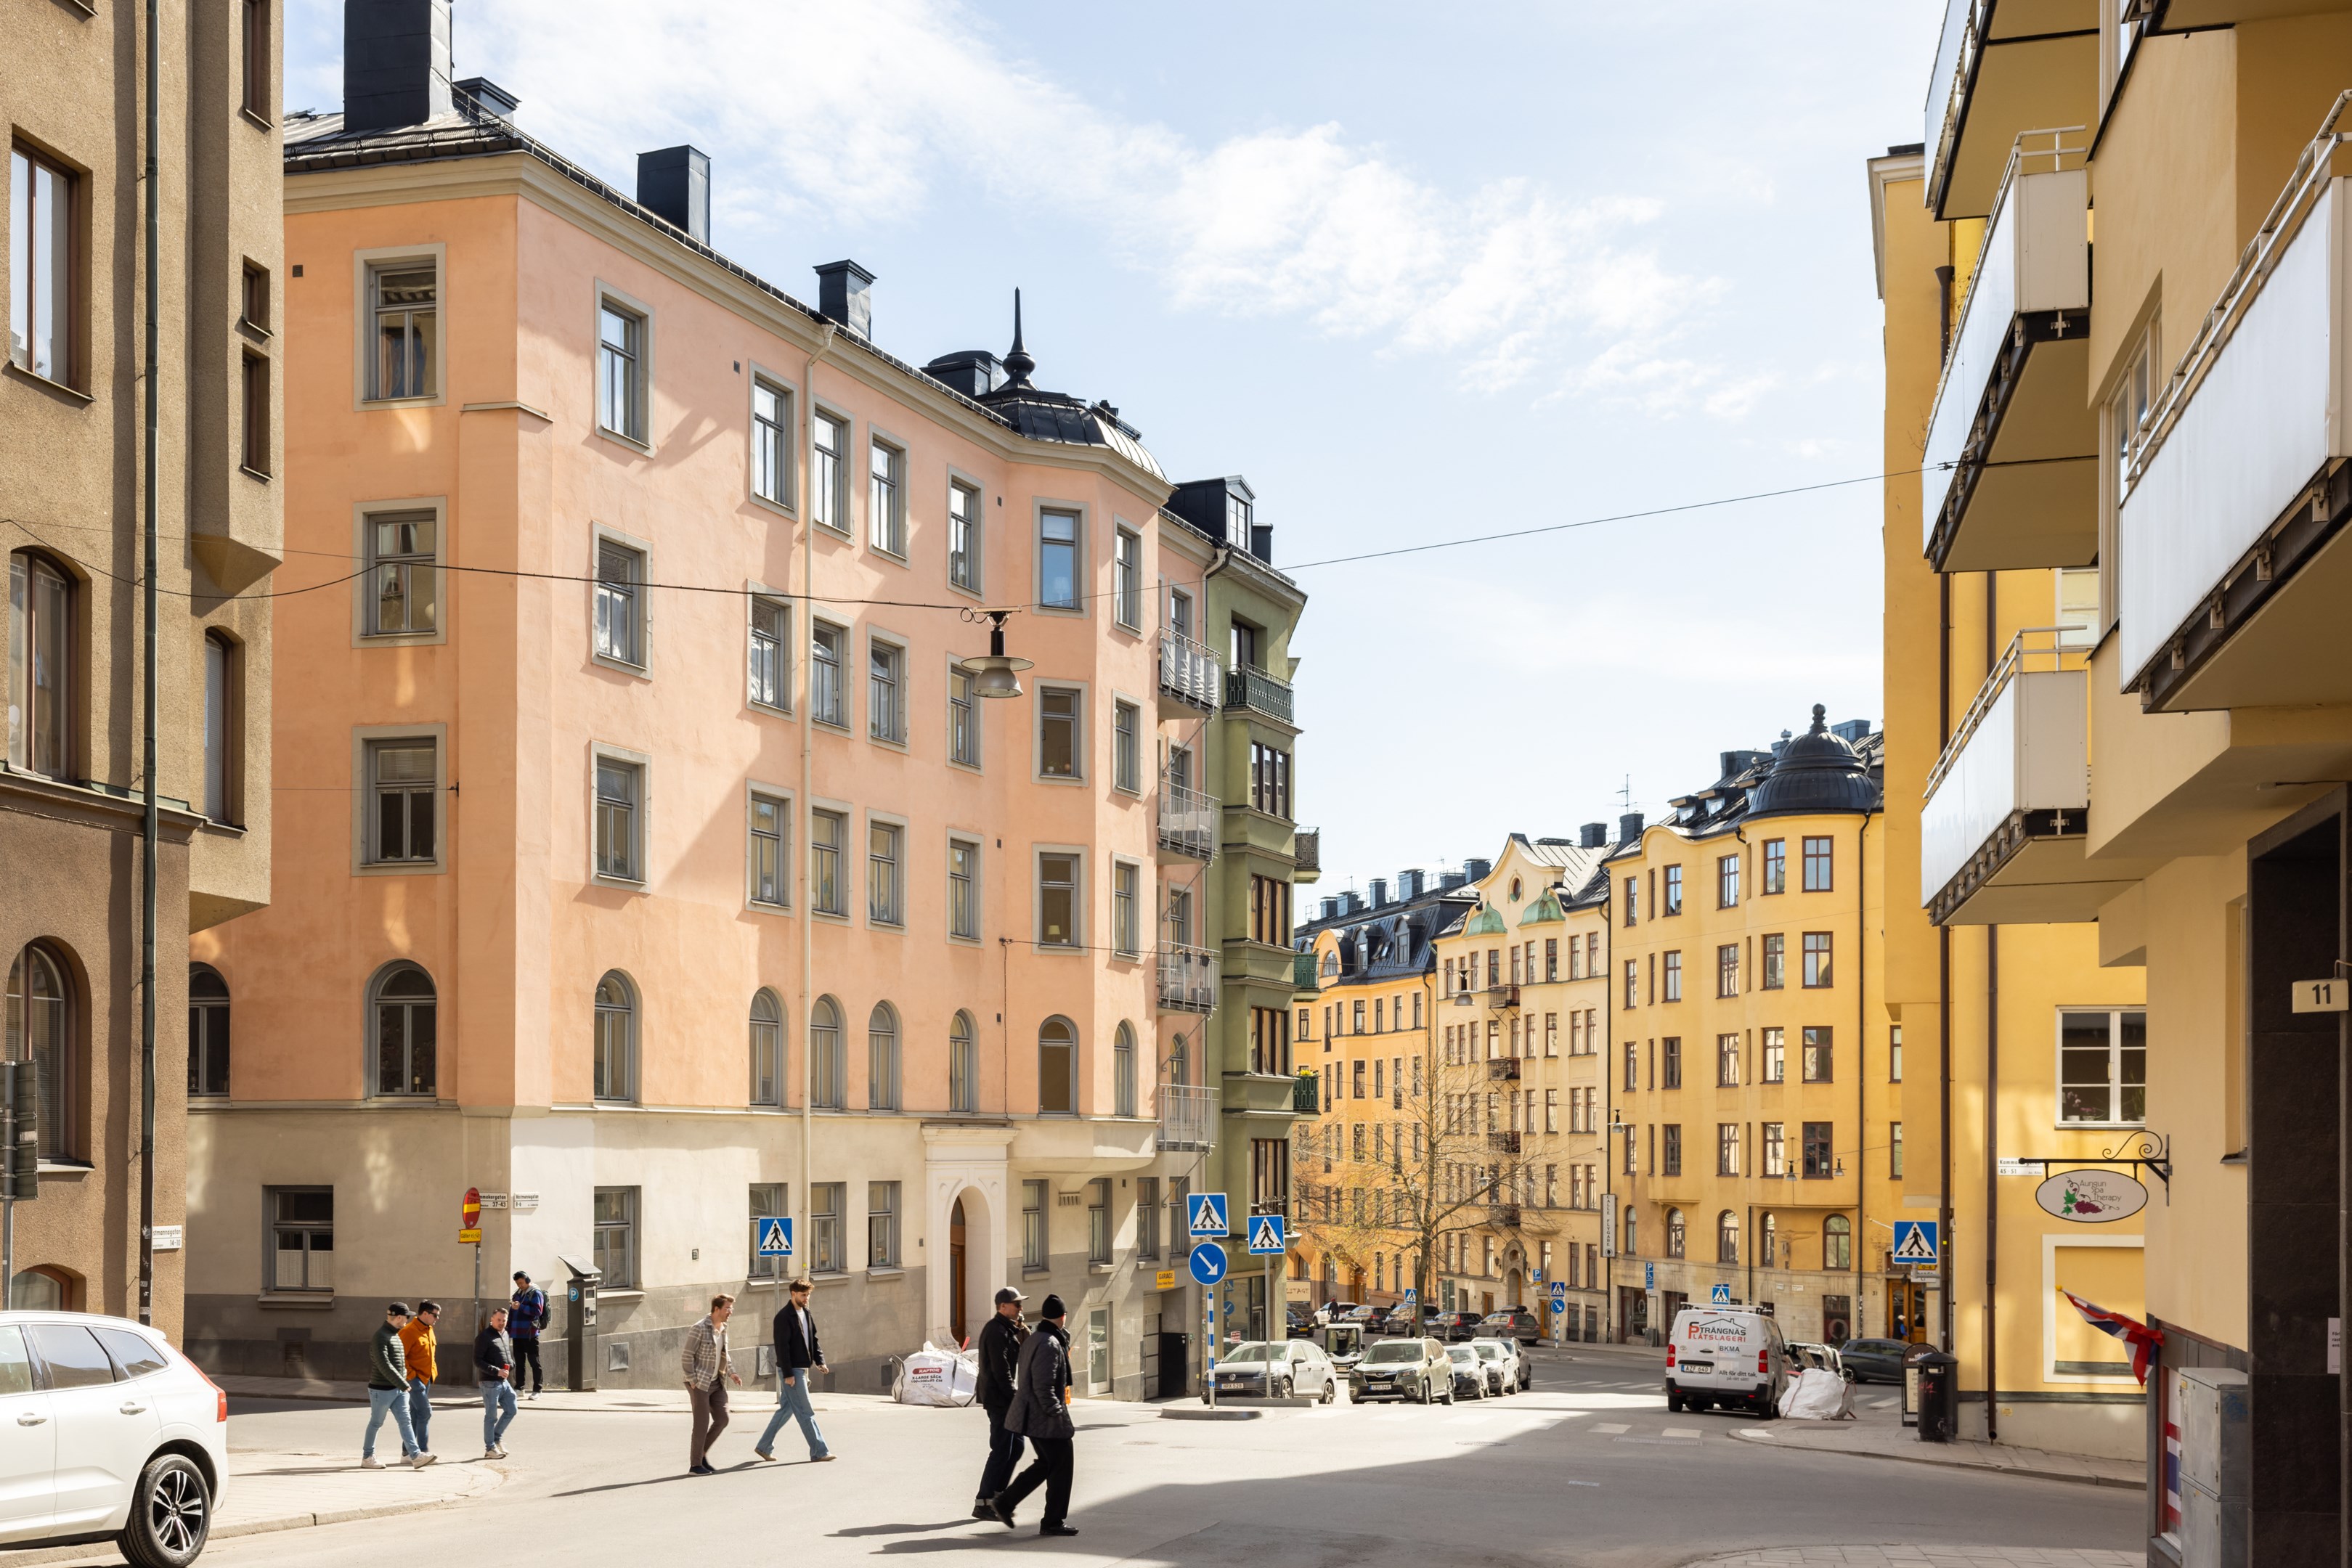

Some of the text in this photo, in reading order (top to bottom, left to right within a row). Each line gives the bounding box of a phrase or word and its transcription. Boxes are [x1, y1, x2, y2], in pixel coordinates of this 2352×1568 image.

[2312, 984, 2331, 1005] 11
[2080, 1180, 2107, 1188] Aungun
[2093, 1193, 2122, 1202] Therapy
